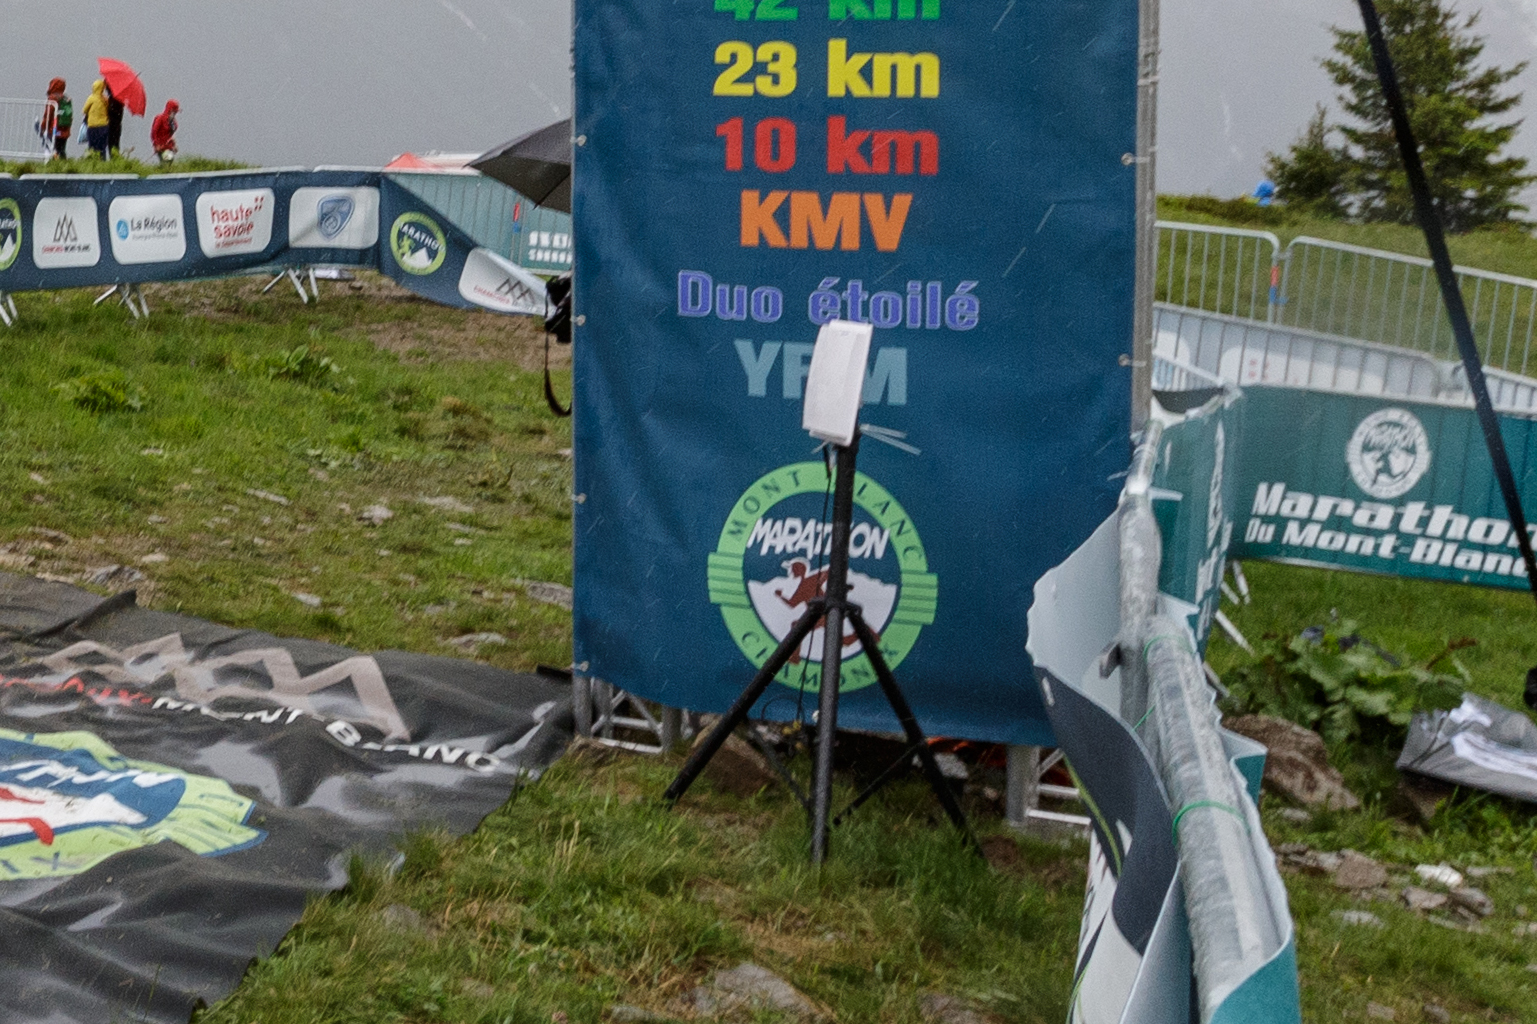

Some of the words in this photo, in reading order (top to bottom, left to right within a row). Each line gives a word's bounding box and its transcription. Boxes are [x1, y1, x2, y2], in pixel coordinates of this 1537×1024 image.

[713, 41, 797, 97] 23
[827, 38, 940, 98] km
[715, 117, 796, 172] 10
[826, 115, 939, 175] km
[210, 204, 253, 224] haute
[740, 190, 912, 252] KMV
[677, 270, 782, 323] Duo
[808, 276, 979, 330] étoilé
[727, 469, 801, 541] MONT
[1244, 516, 1276, 544] Du
[746, 516, 891, 561] MARATON
